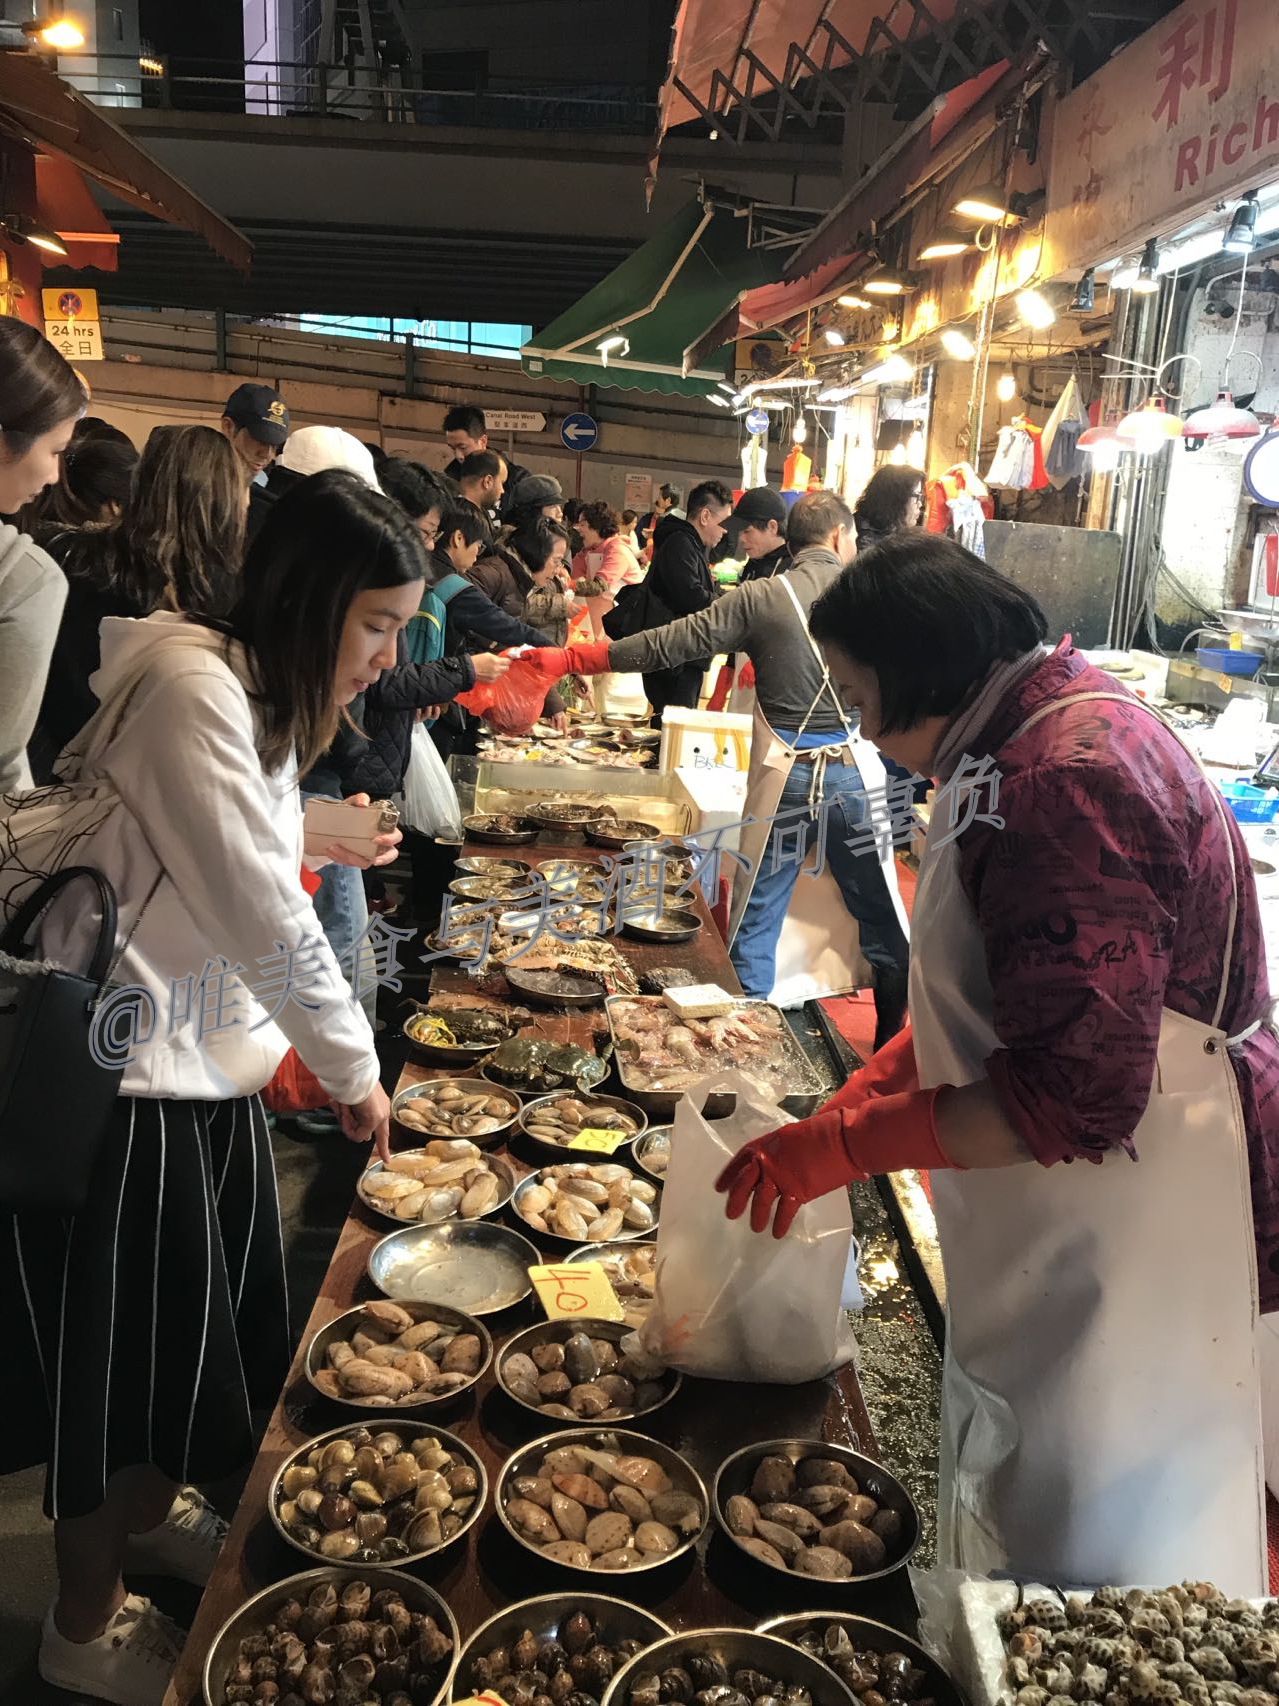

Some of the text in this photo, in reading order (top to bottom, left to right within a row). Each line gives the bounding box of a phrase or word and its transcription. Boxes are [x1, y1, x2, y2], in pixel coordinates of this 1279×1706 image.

[1152, 0, 1238, 132] 利
[52, 325, 94, 337] 24 hrs
[59, 340, 92, 356] 全日
[485, 411, 503, 419] Canal
[504, 412, 520, 420] Road
[584, 1131, 617, 1149] 50
[533, 1268, 591, 1313] 40
